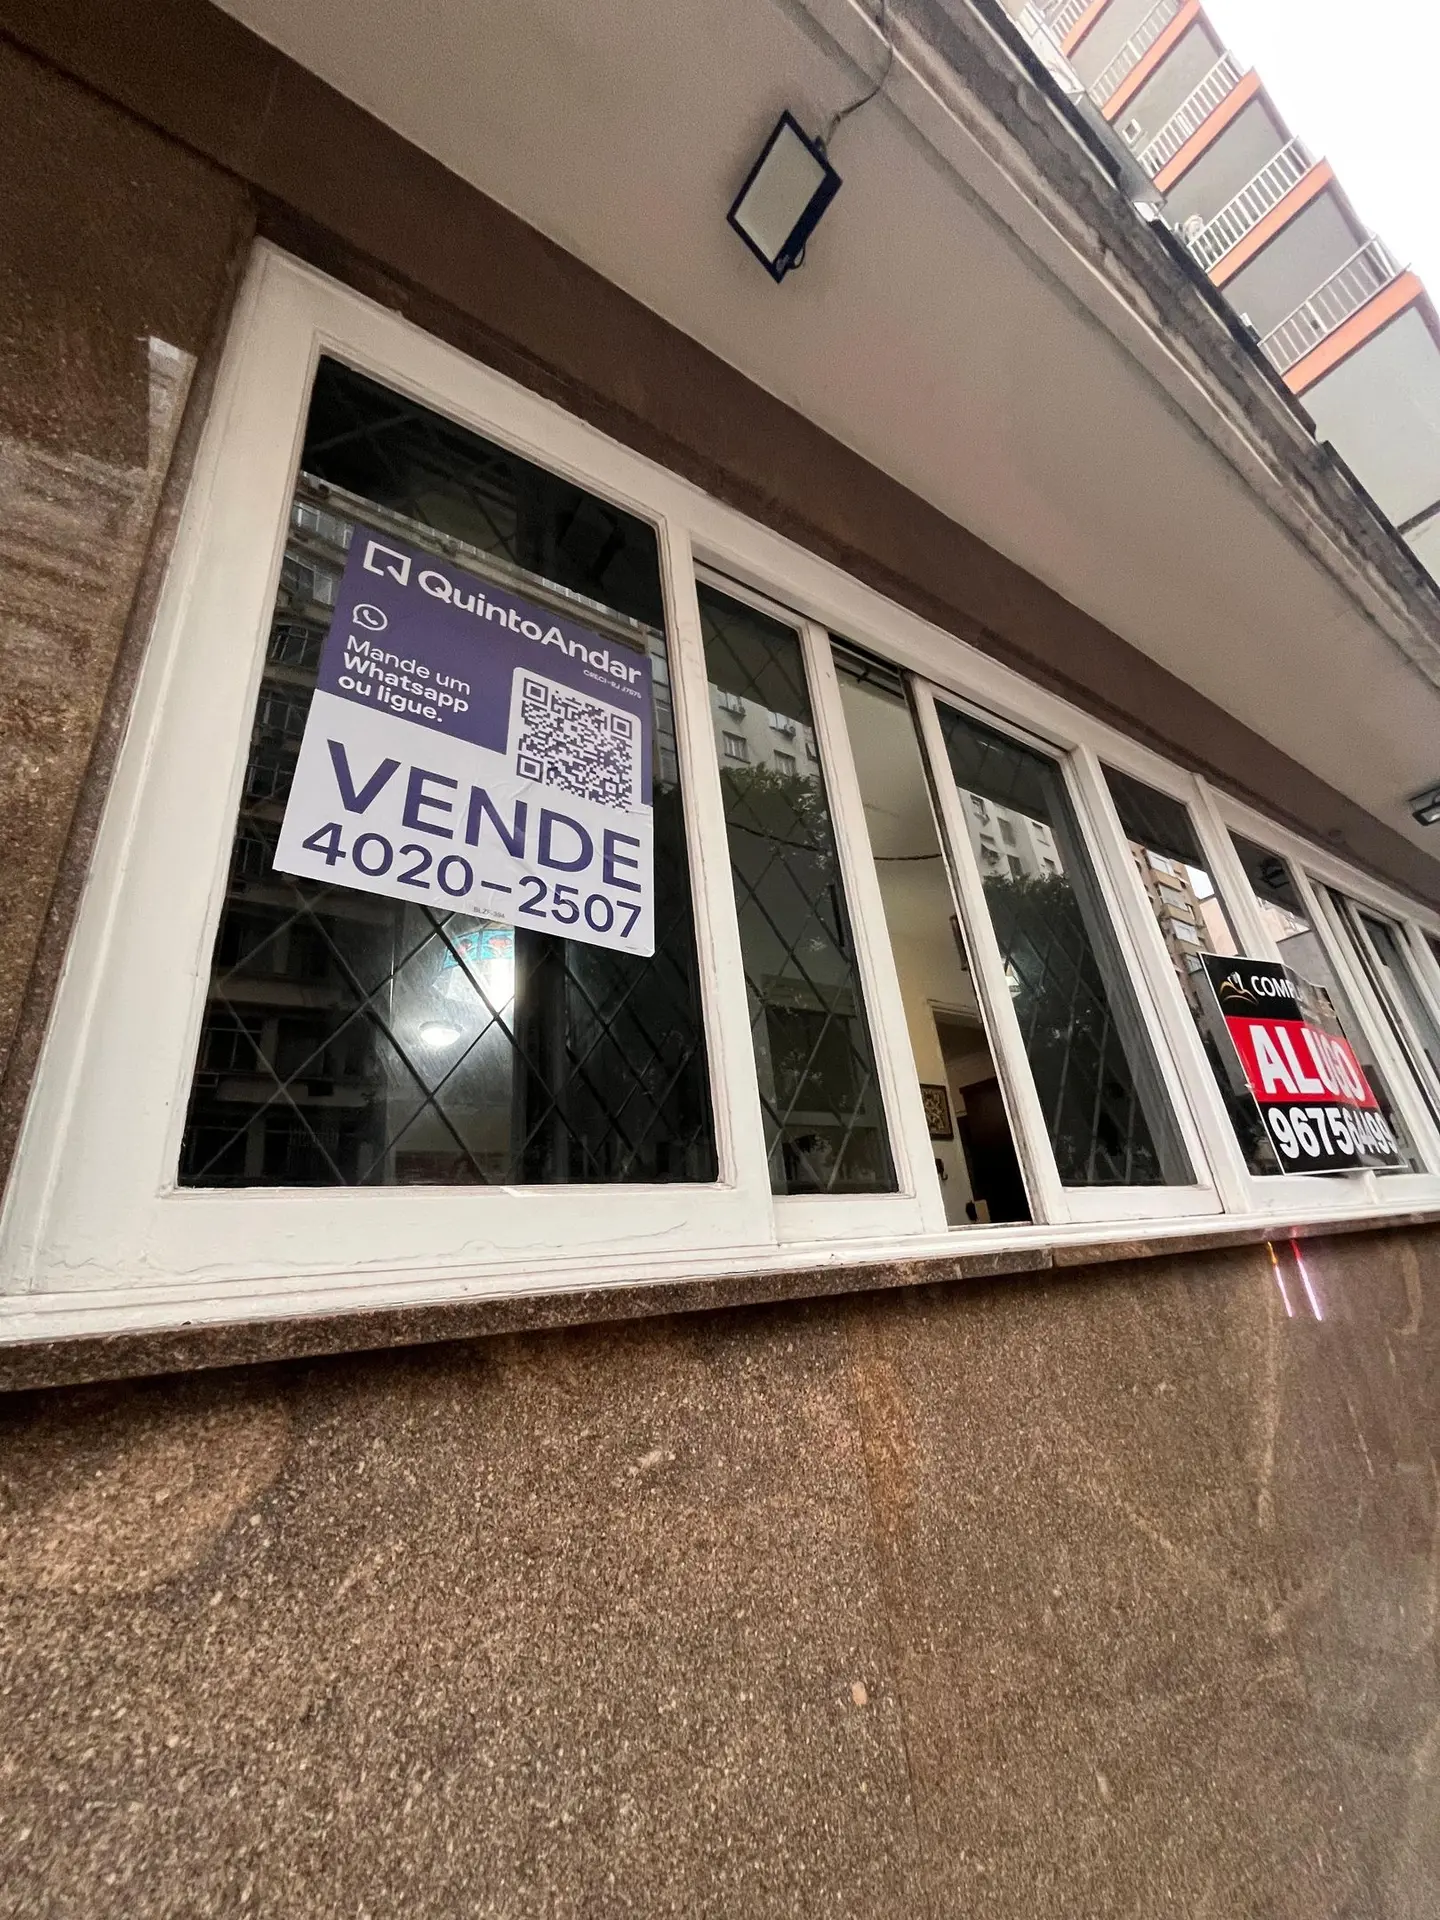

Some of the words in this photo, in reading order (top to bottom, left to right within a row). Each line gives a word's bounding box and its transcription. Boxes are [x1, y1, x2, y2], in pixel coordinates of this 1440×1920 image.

[347, 634, 430, 679] Mande
[436, 672, 470, 695] um
[417, 570, 642, 684] QuintoAndar
[338, 675, 371, 696] ou
[377, 684, 443, 723] ligue.
[343, 651, 469, 713] Whatsapp
[326, 738, 642, 894] VENDE
[302, 821, 642, 939] 4020-2507
